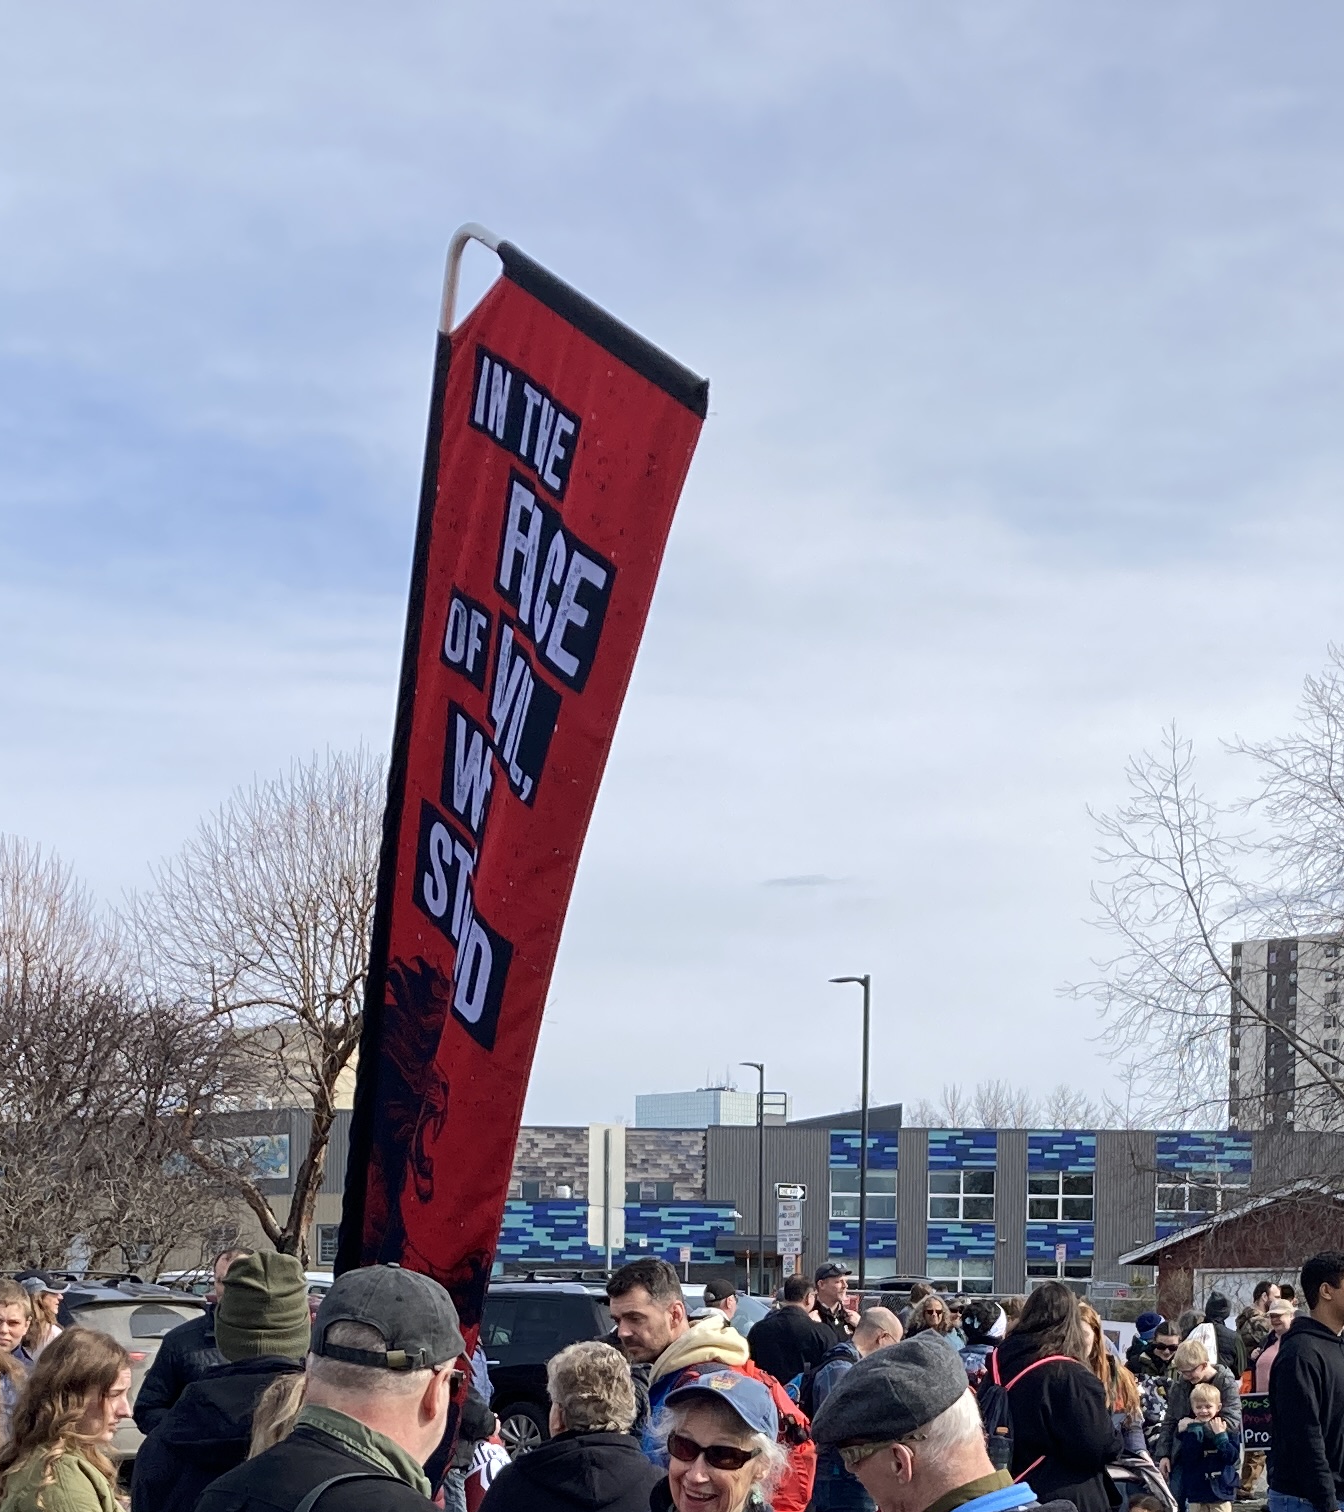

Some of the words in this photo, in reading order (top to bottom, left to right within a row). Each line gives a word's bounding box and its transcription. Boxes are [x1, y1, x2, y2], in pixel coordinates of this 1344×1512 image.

[474, 356, 513, 440] IN
[519, 380, 577, 492] THE
[444, 598, 487, 674] OF
